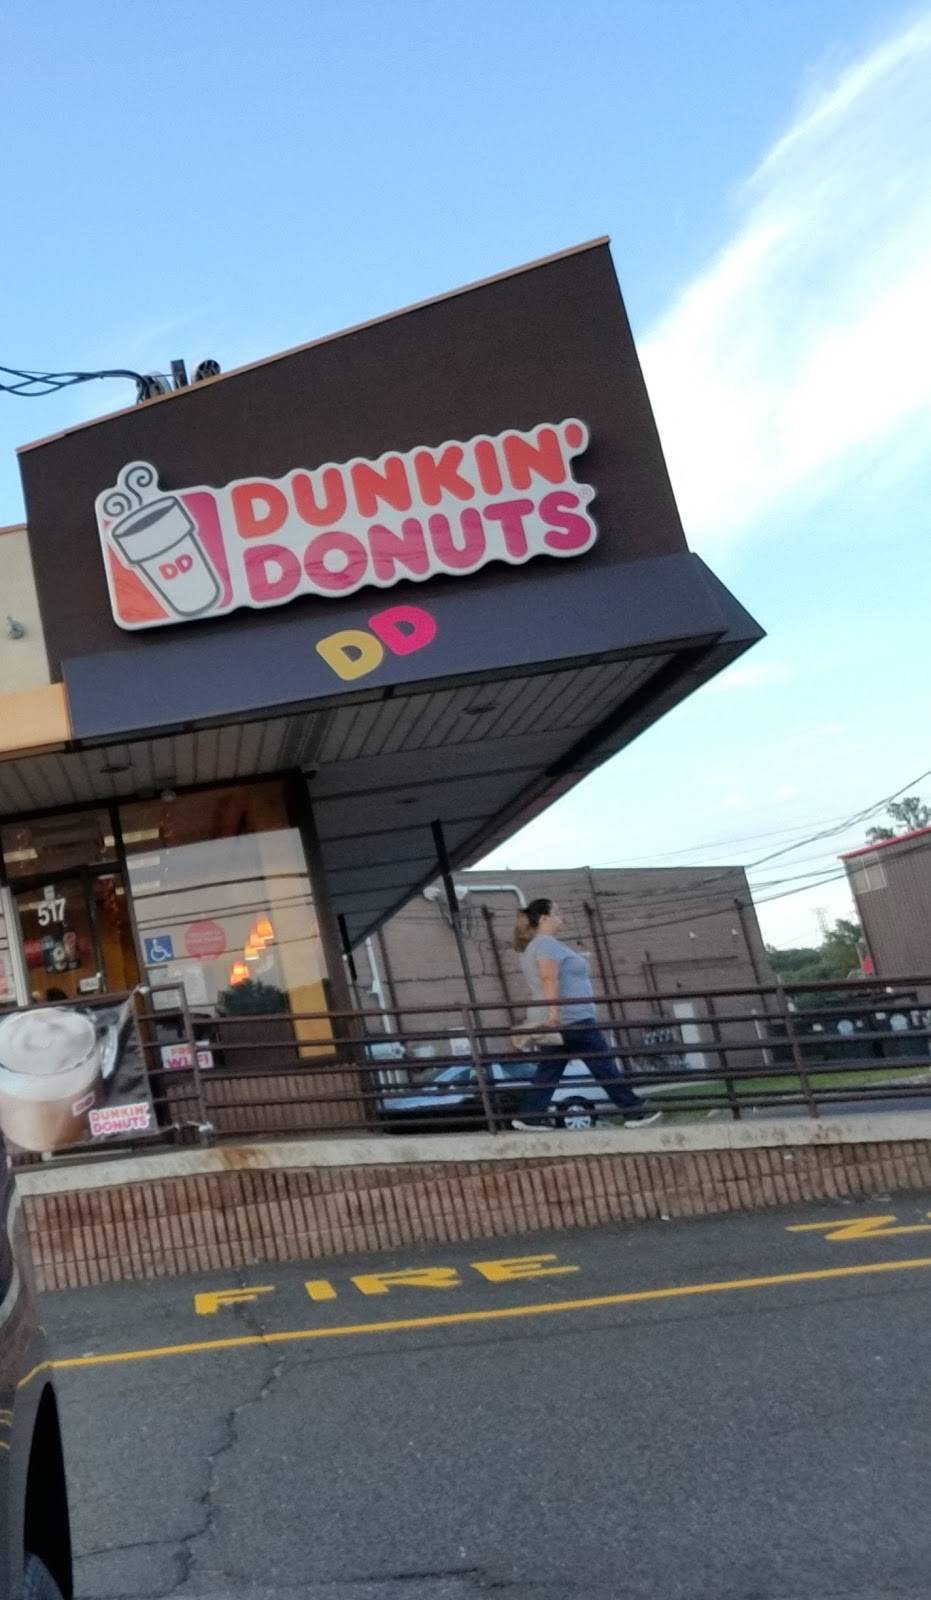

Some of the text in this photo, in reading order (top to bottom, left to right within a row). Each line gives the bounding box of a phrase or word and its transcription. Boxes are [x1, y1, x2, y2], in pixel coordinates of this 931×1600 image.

[231, 423, 583, 539] DUNKIN'
[159, 554, 193, 580] DD
[244, 490, 591, 602] DONUTS
[316, 605, 437, 681] DD
[38, 898, 66, 927] 517
[95, 1115, 147, 1133] DONUTS
[195, 1254, 580, 1315] FIRE
